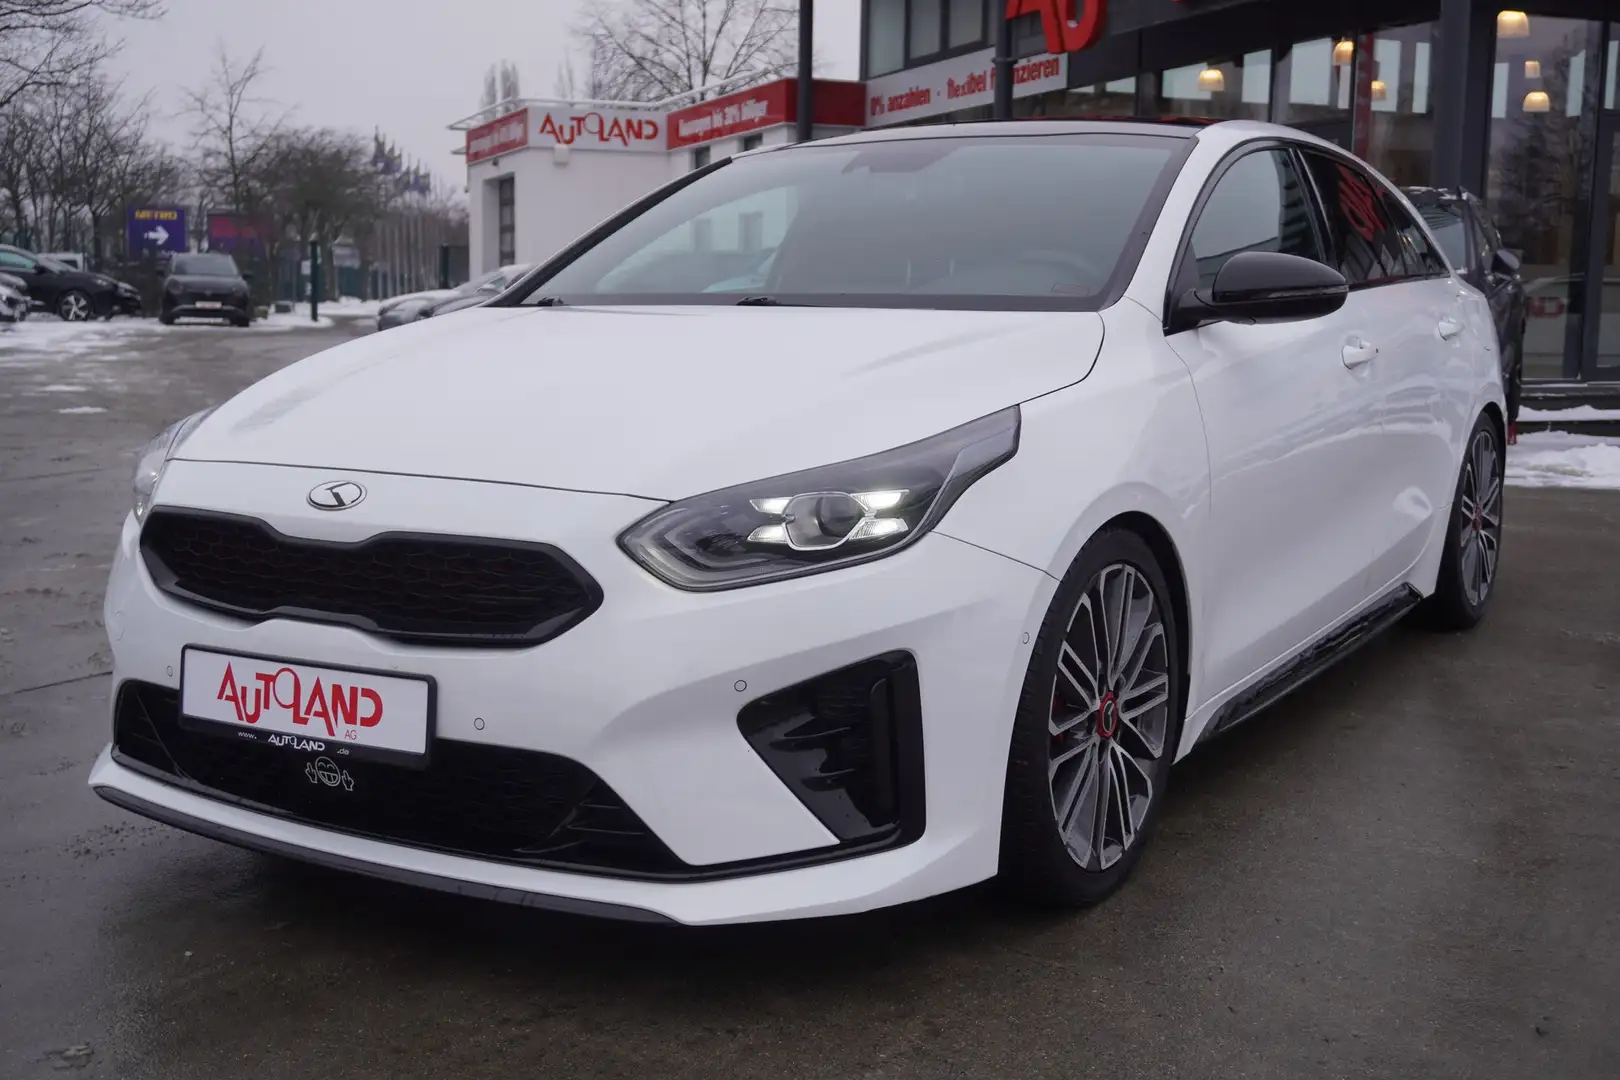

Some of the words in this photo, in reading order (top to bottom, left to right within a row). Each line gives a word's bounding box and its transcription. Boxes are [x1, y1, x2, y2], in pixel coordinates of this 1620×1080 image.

[887, 85, 931, 112] anzahlen
[539, 112, 659, 147] AUTOLAND
[217, 661, 383, 737] AUTOLAND
[238, 731, 258, 740] www.
[344, 729, 357, 740] AG
